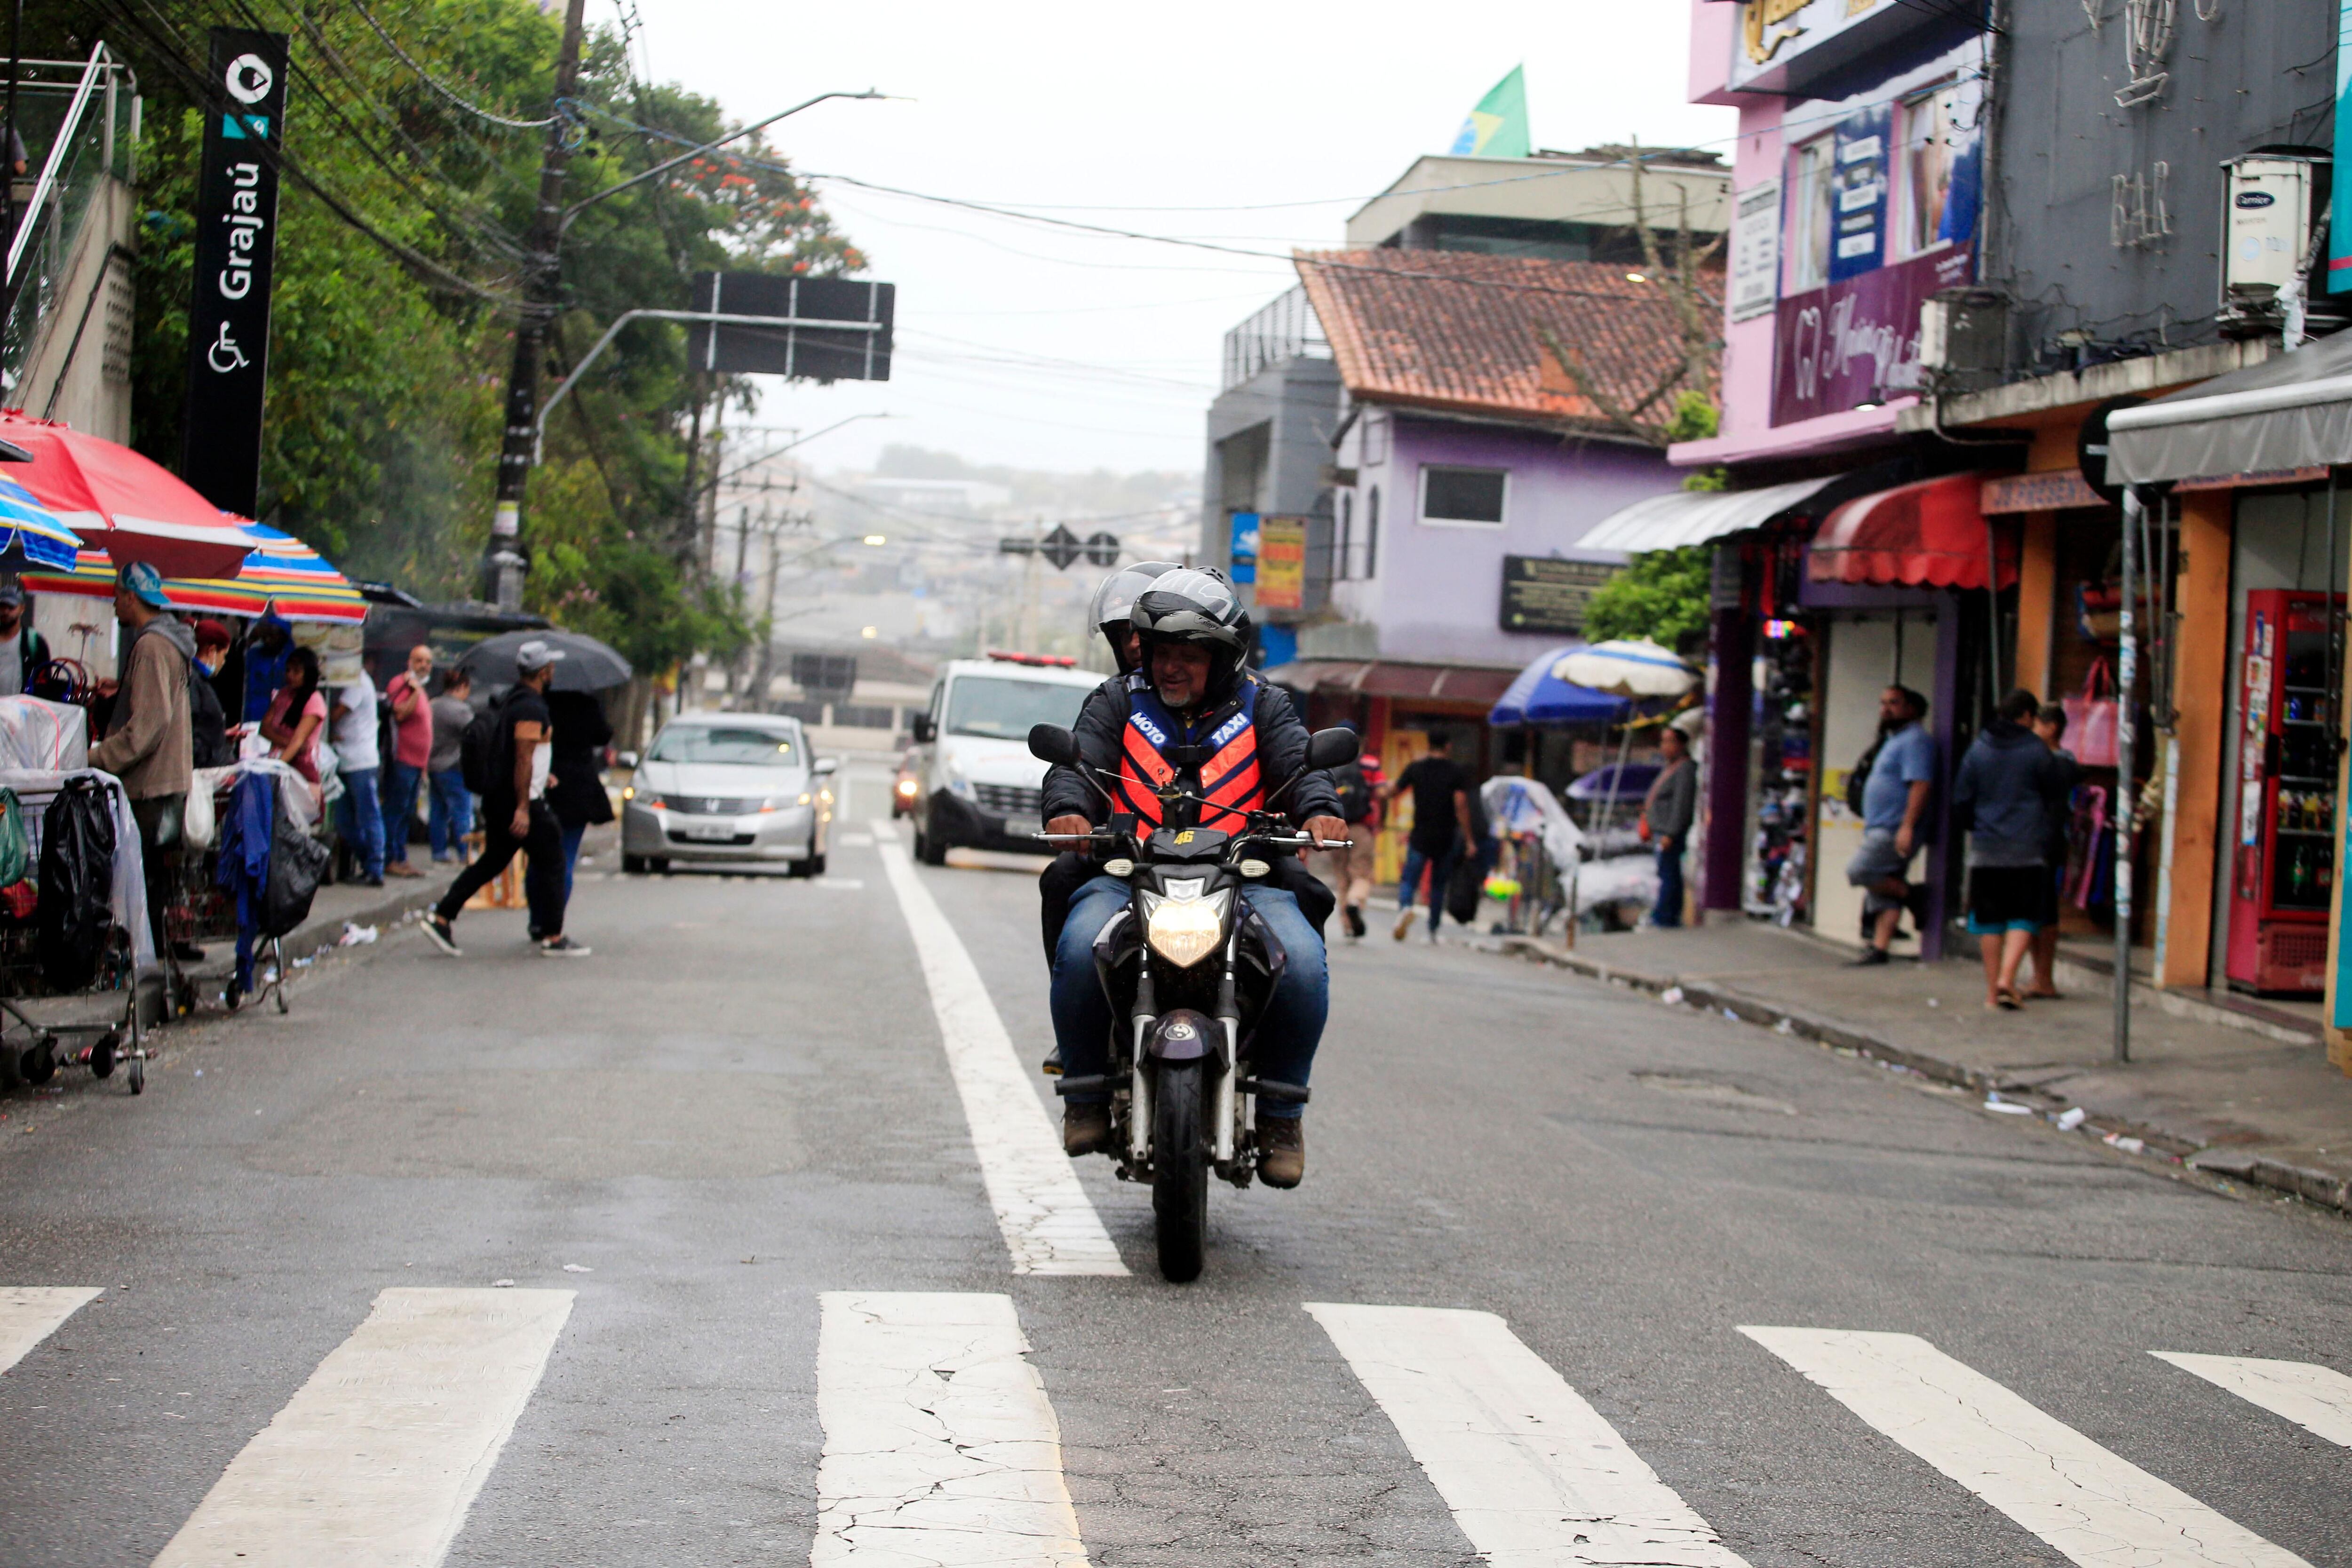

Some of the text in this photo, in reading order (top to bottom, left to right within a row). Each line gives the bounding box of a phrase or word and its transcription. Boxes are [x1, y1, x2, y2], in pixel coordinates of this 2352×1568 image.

[253, 119, 265, 135] 9
[219, 162, 265, 301] Grajaú
[1129, 712, 1247, 745] MOTO TAXI
[1173, 830, 1194, 845] 46
